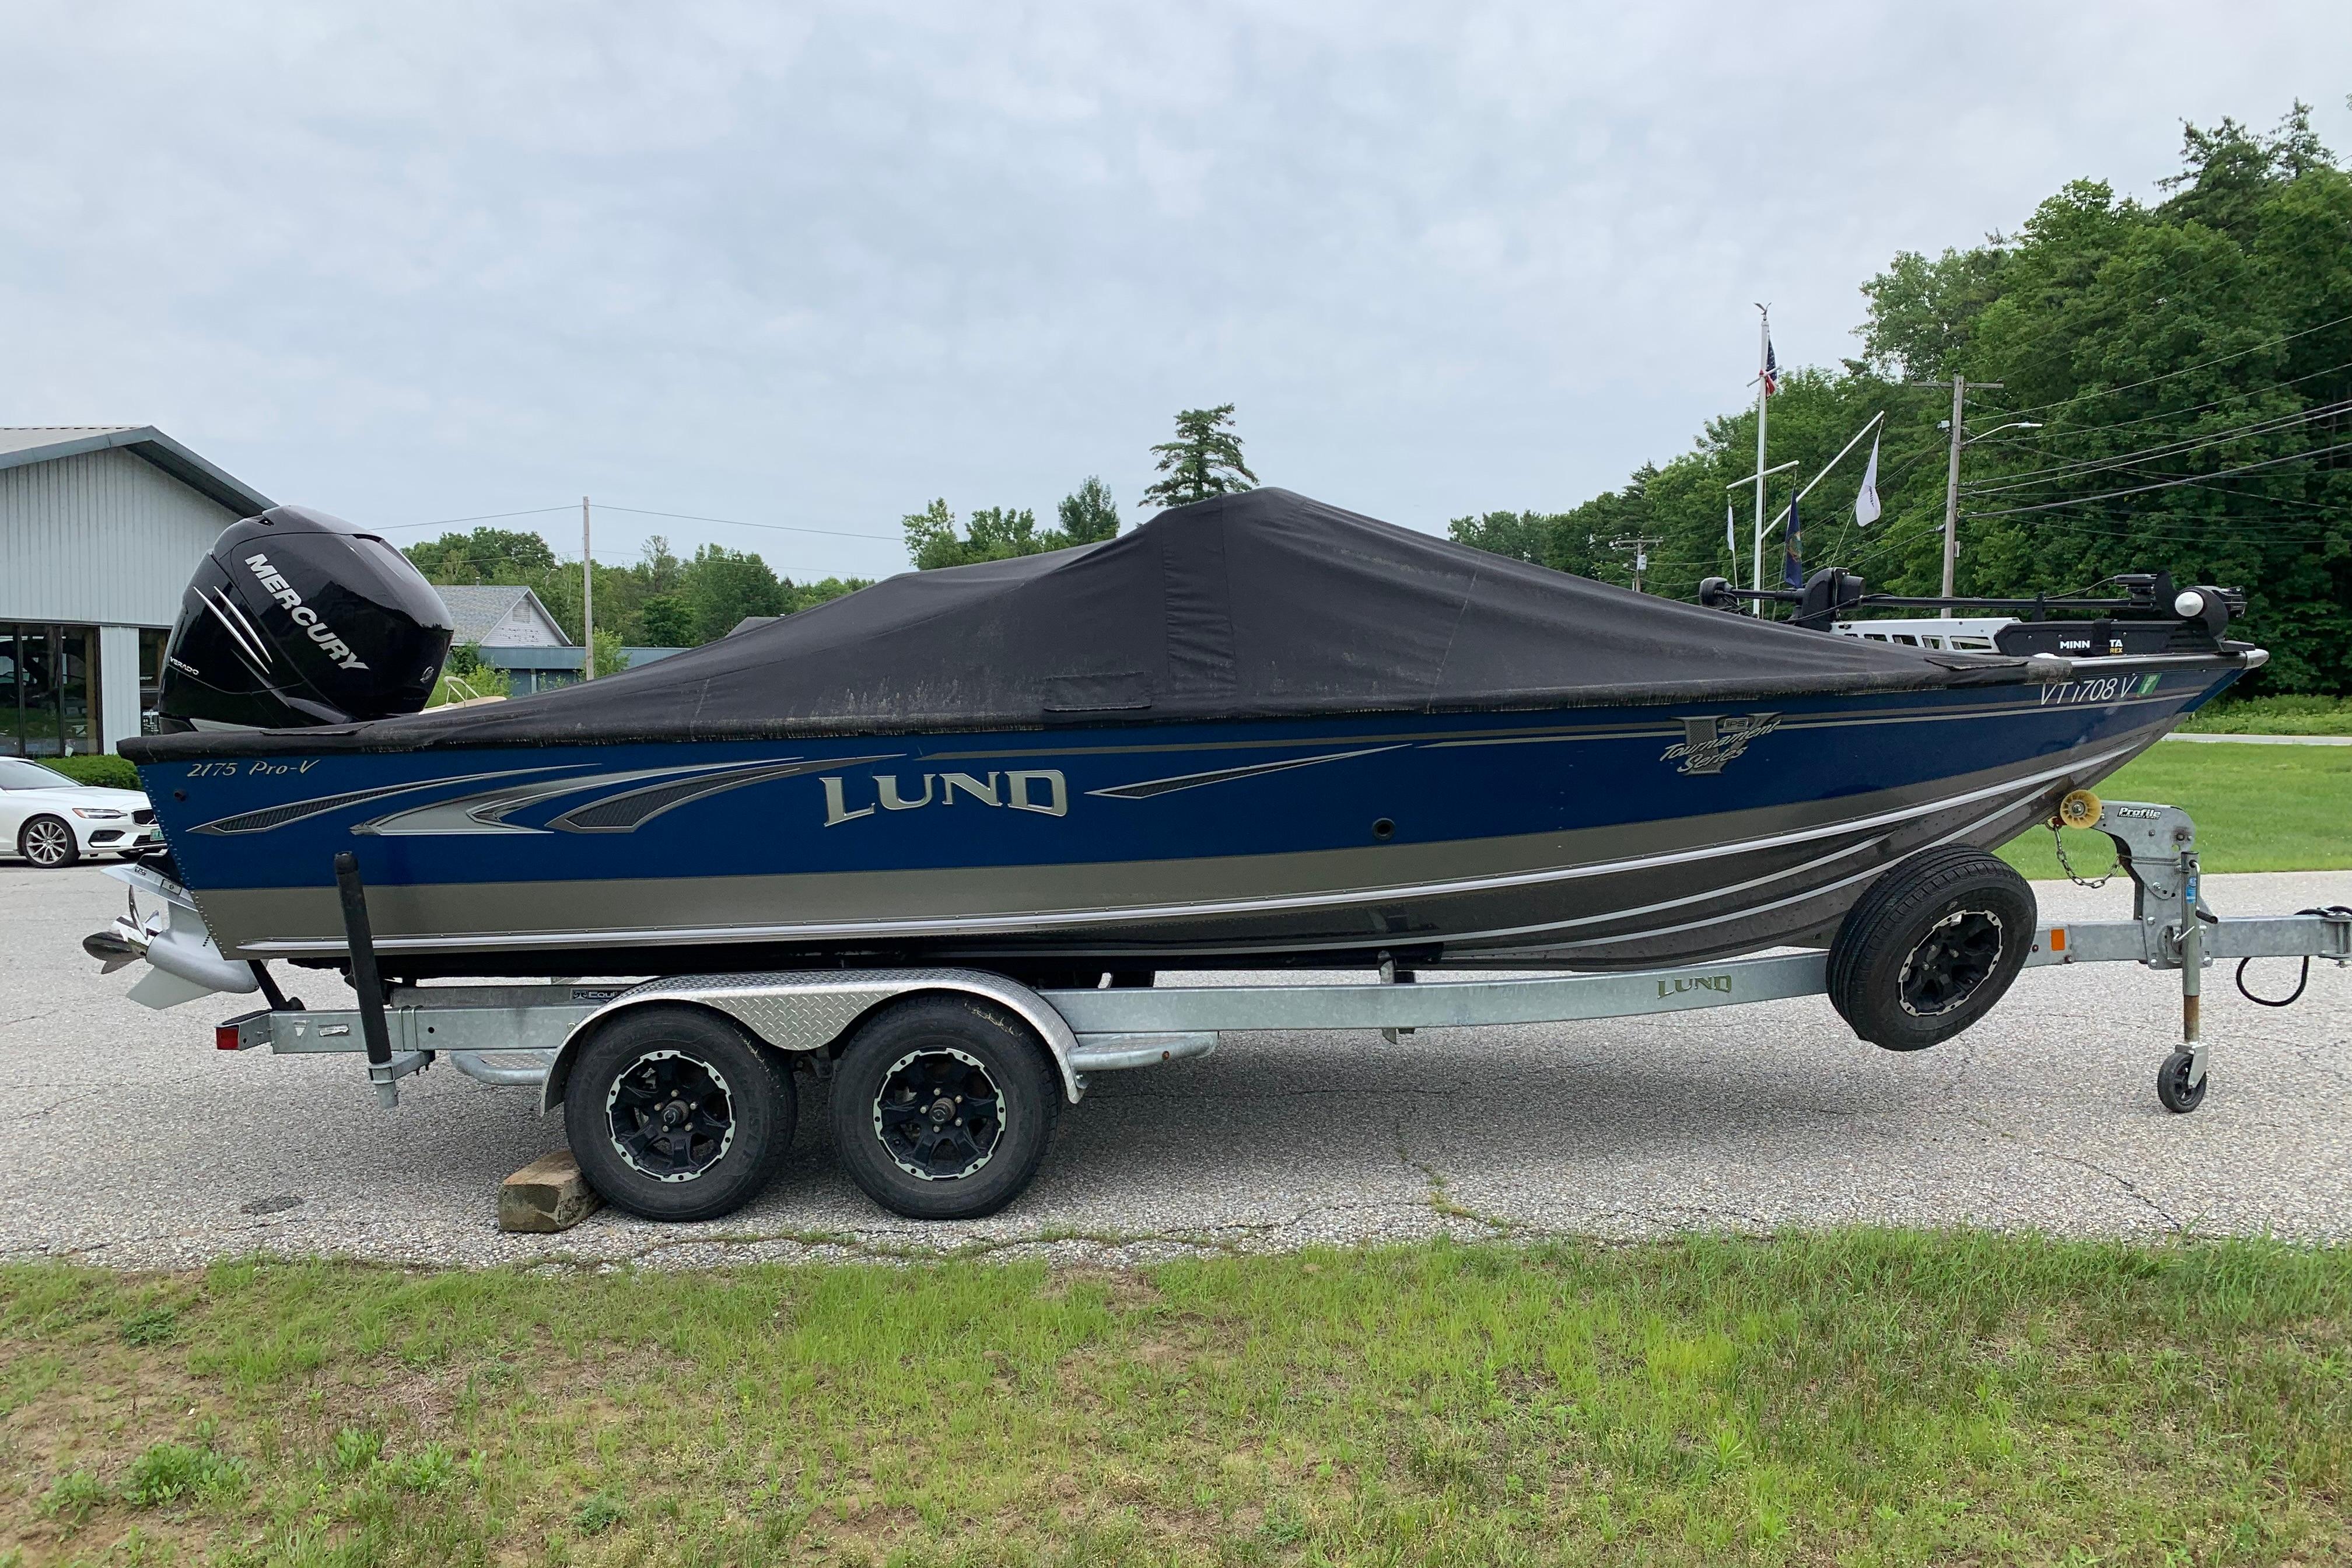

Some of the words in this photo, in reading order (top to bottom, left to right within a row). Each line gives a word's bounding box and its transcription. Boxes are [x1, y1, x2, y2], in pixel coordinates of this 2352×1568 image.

[244, 553, 370, 670] MERCURY
[2060, 640, 2091, 649] MINN
[2109, 639, 2123, 648] TA
[170, 656, 199, 676] VERADO
[1659, 719, 1782, 761] Tournament
[187, 762, 238, 777] 2175
[249, 759, 321, 775] Pro-V
[1676, 746, 1748, 772] Series
[819, 769, 1069, 827] LUND
[2119, 807, 2162, 818] Profile
[1657, 975, 1732, 999] LUND
